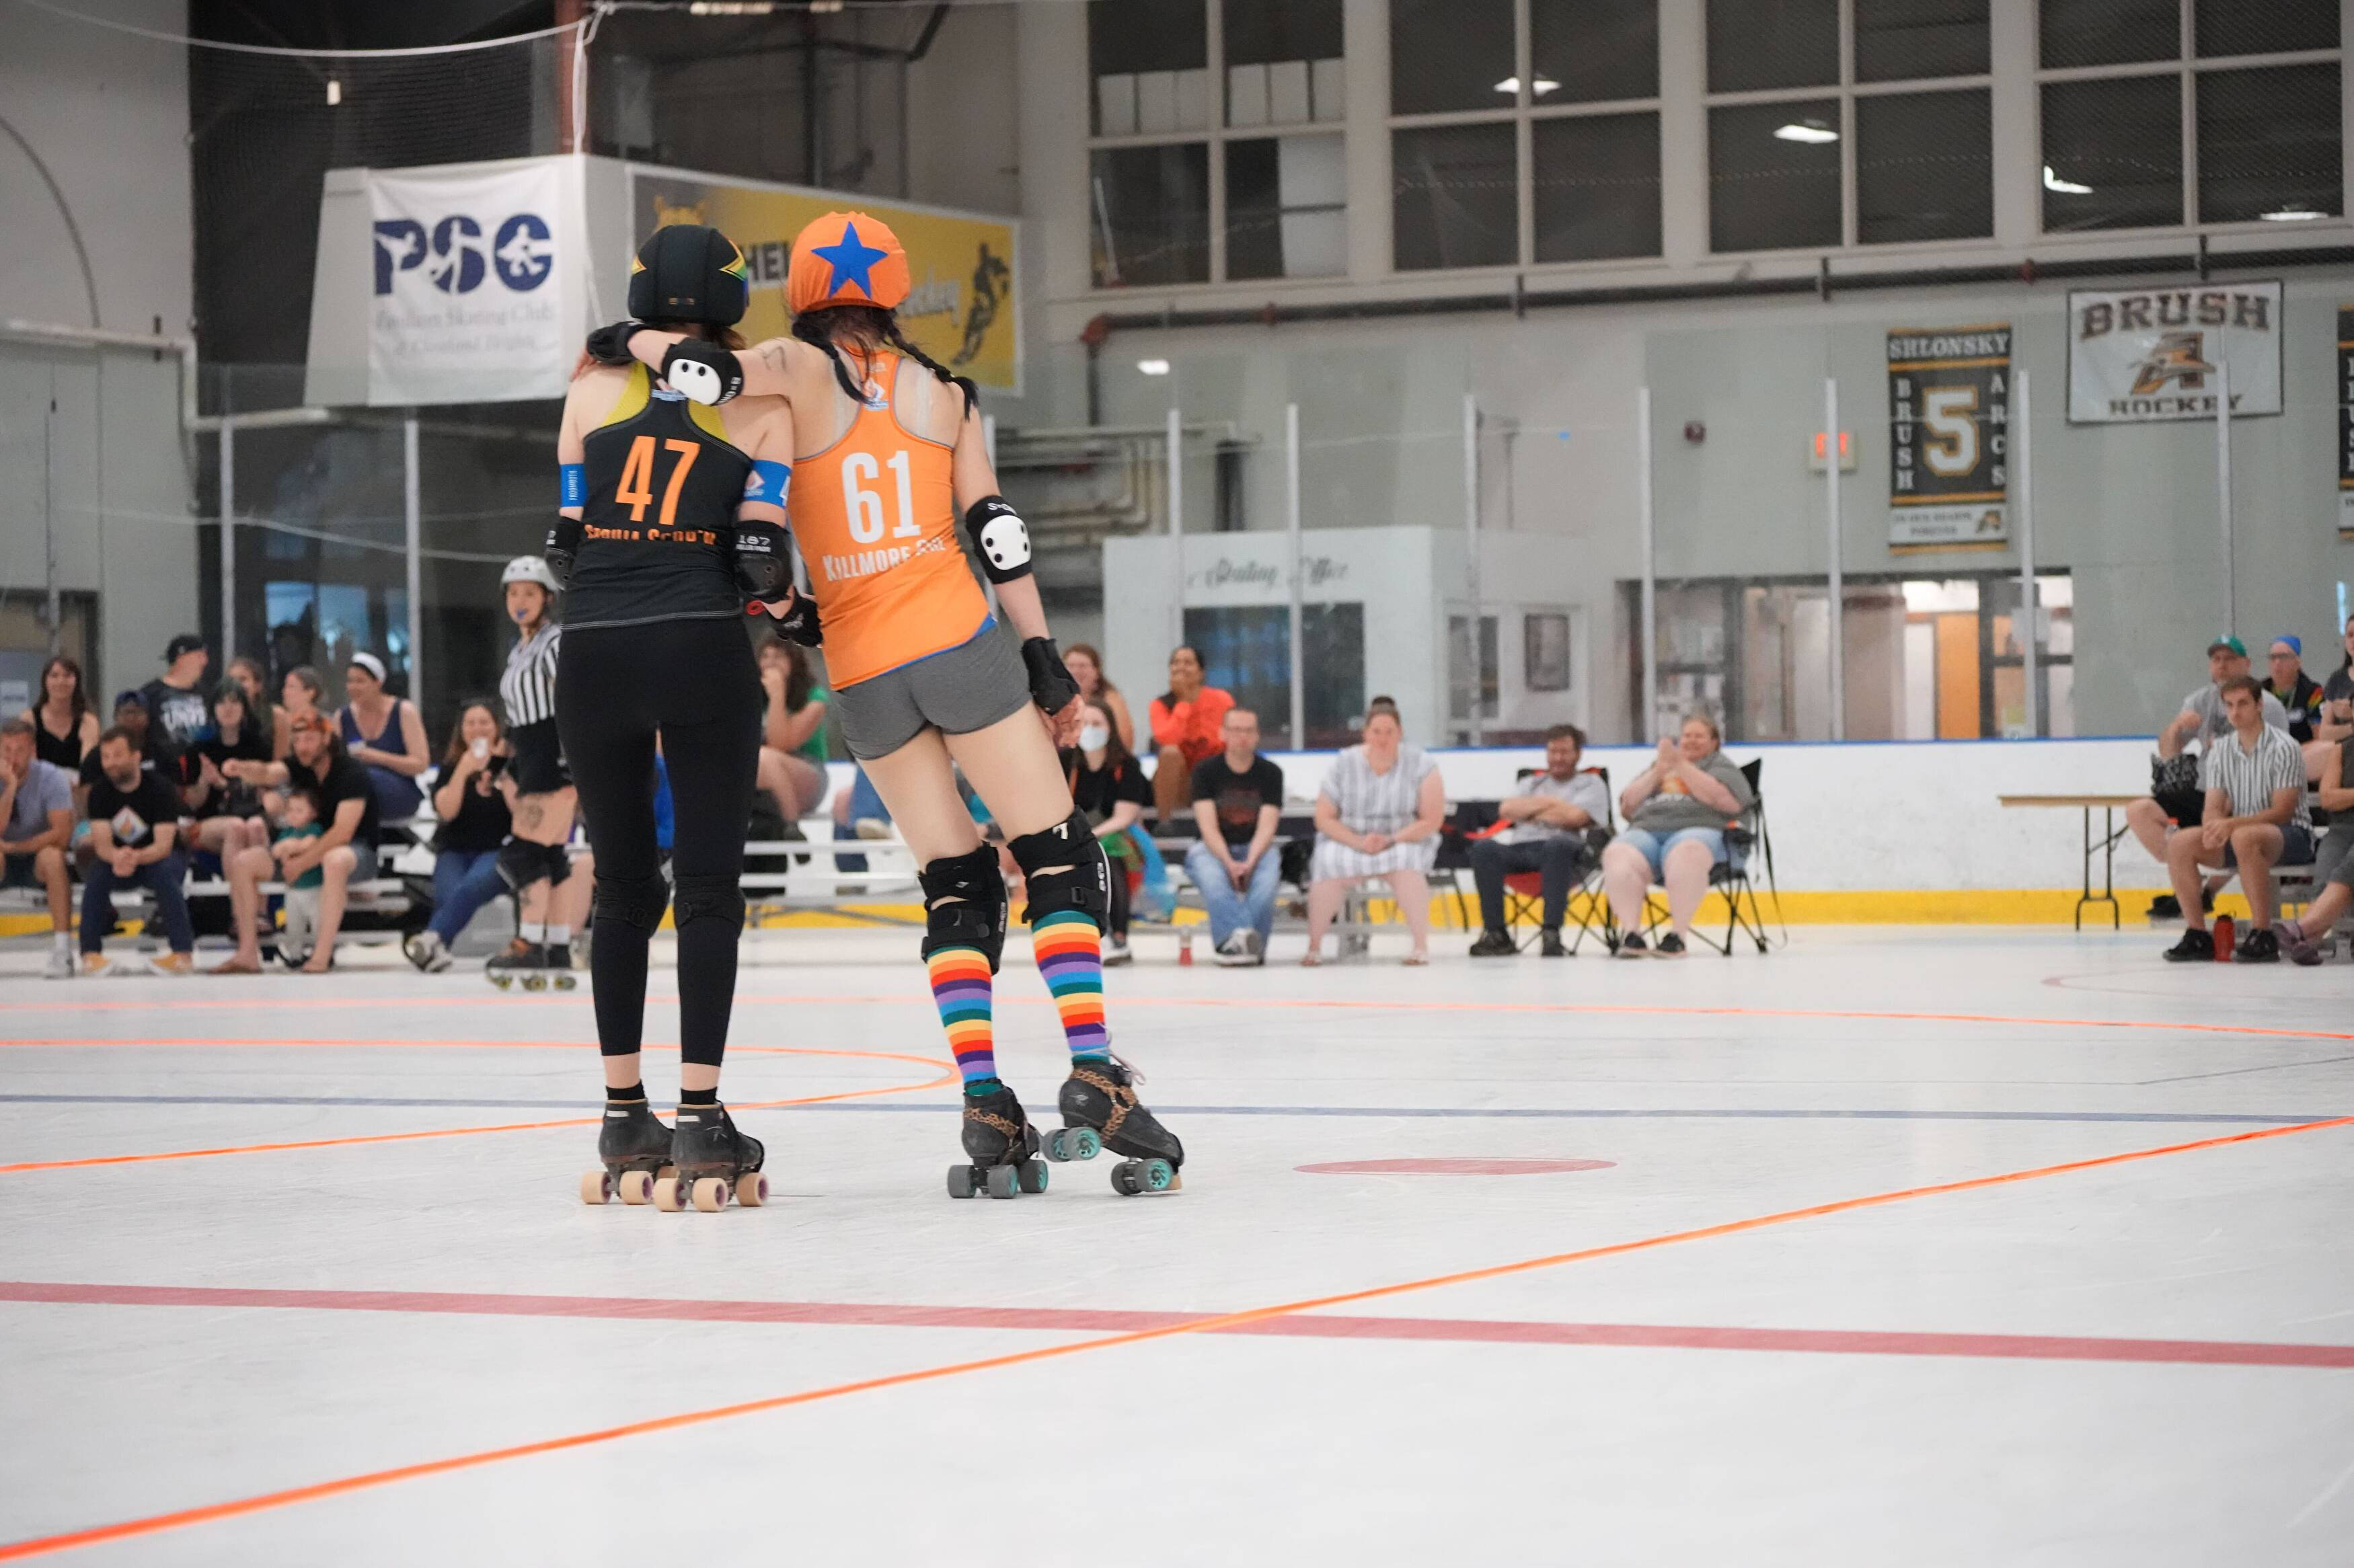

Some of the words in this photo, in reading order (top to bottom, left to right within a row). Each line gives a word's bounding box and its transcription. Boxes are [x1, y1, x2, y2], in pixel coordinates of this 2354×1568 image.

[2082, 292, 2271, 340] BRUSH
[1896, 377, 1915, 491] BRUSH
[1922, 385, 1981, 477] 5
[1990, 373, 2007, 486] ARCS
[615, 436, 700, 525] 47
[841, 450, 921, 543] 61
[738, 535, 771, 546] 187
[823, 546, 911, 582] KILLMORE
